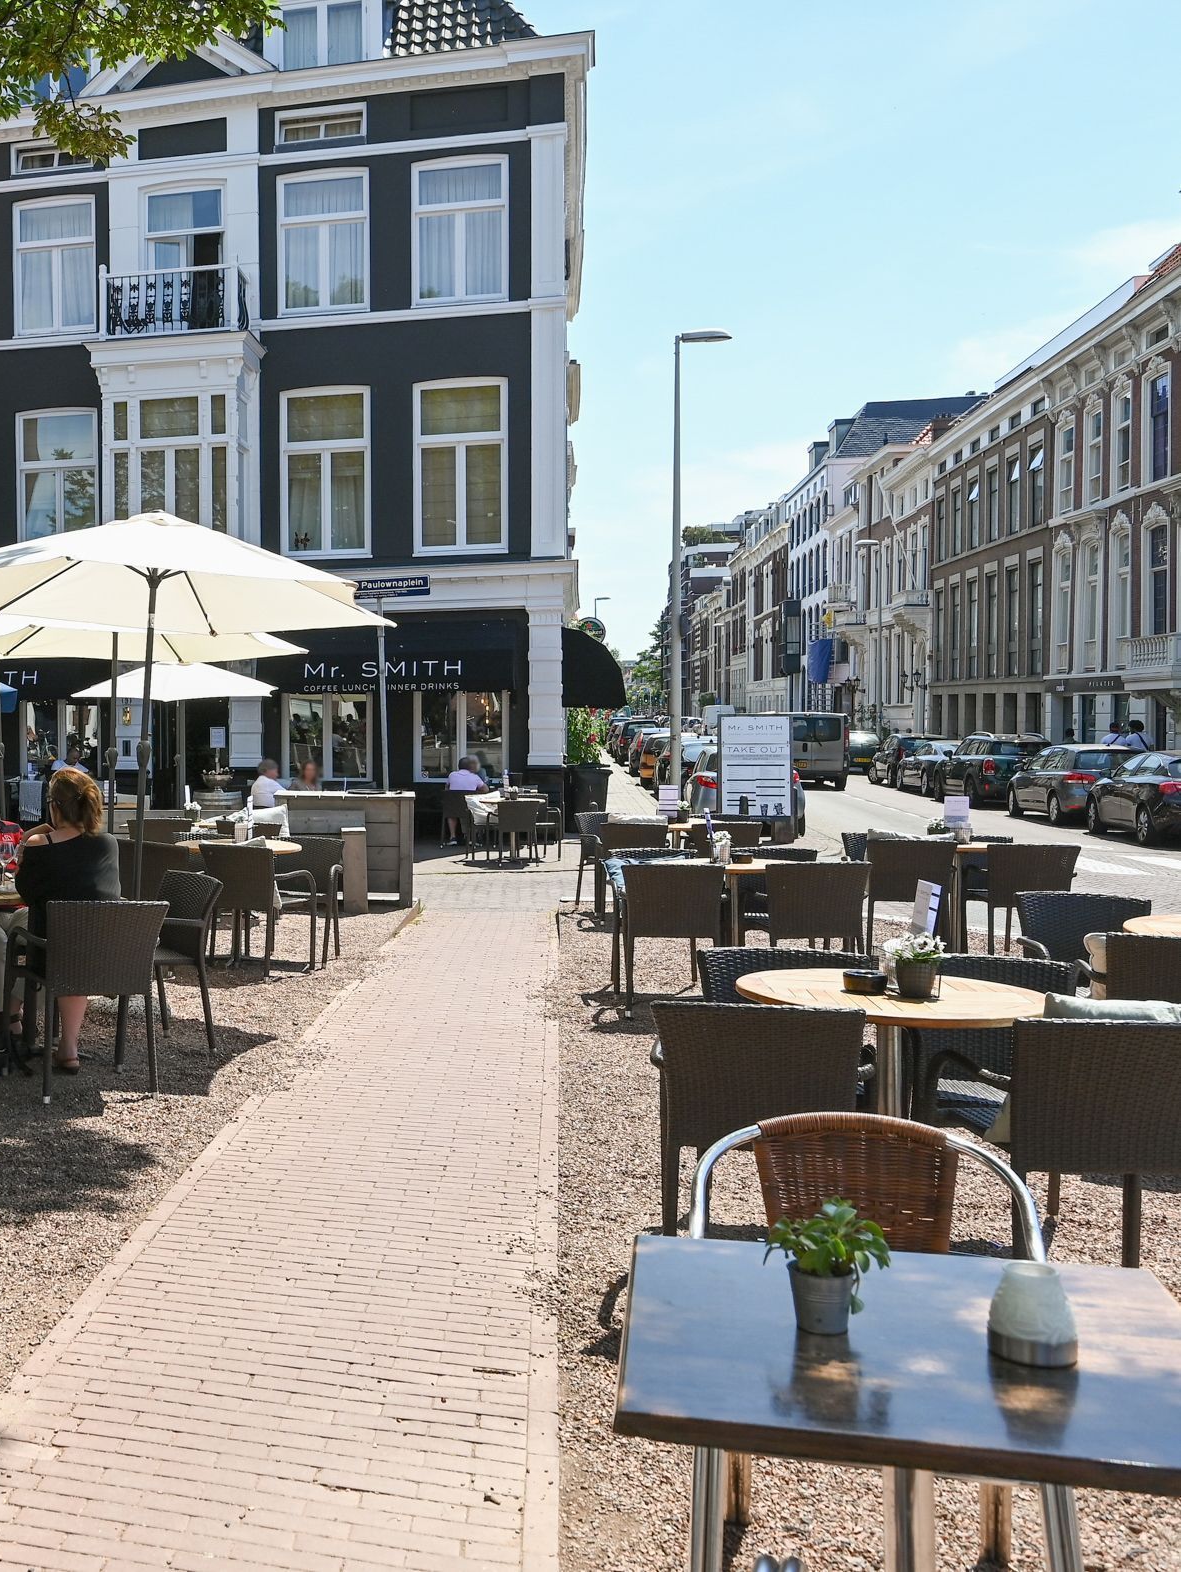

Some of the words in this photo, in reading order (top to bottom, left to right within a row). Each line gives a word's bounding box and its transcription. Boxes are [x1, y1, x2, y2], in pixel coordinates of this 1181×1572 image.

[361, 578, 424, 589] Paulownaplein
[304, 663, 346, 679] Mr.
[361, 660, 463, 678] SMITH
[303, 684, 339, 693] COFFEE
[342, 683, 376, 692] LUNCH
[386, 682, 417, 691] INNER
[420, 682, 460, 691] DRINKS
